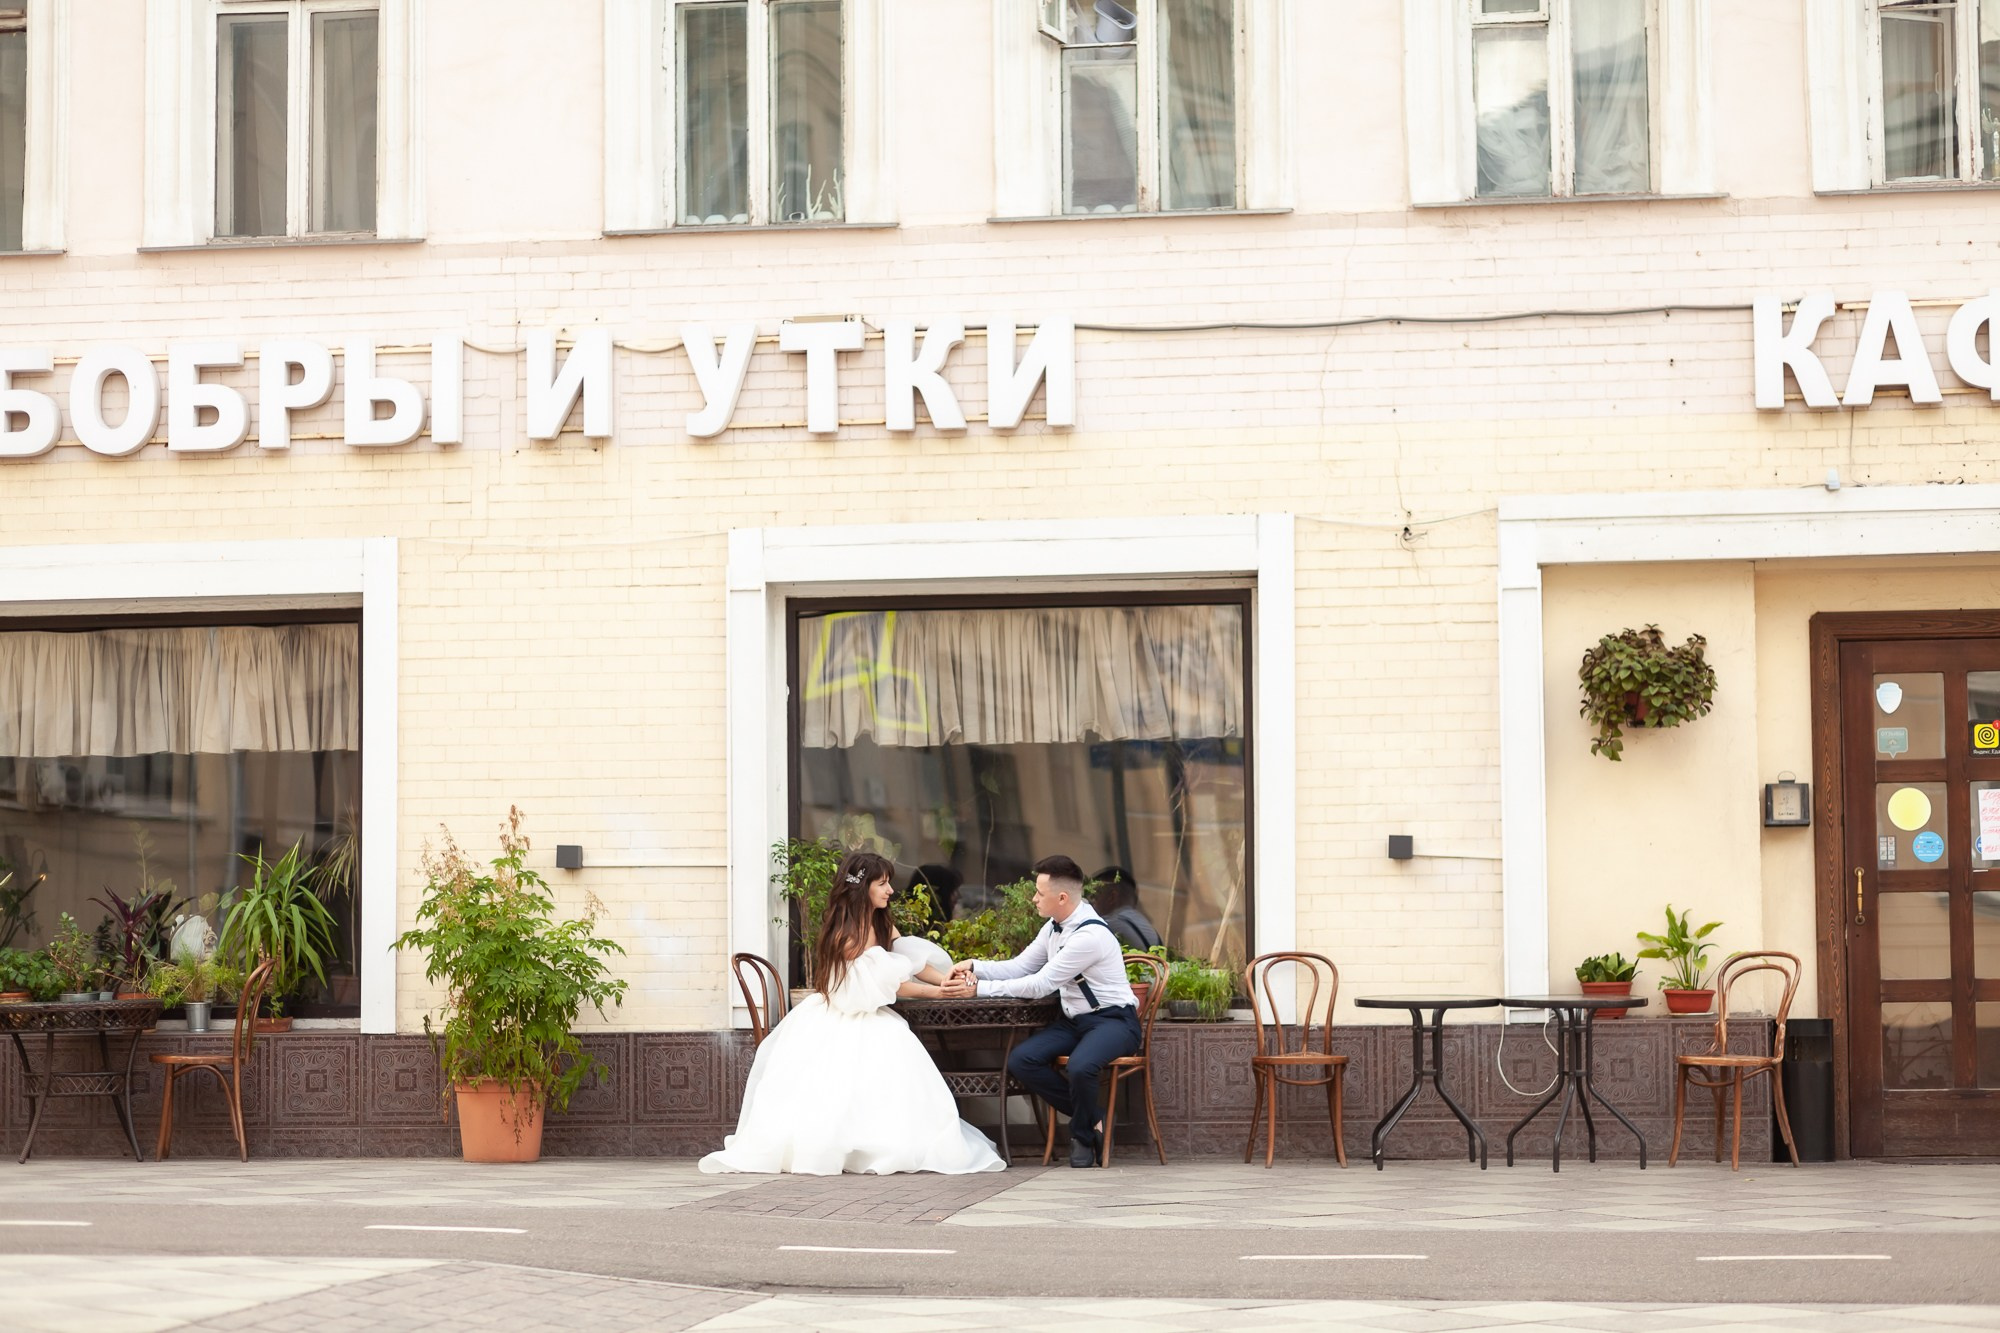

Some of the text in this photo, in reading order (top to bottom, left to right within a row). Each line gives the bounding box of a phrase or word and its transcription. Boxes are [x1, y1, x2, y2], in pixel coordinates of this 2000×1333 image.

[0, 317, 1076, 457] БОБРЫ И УТКИ
